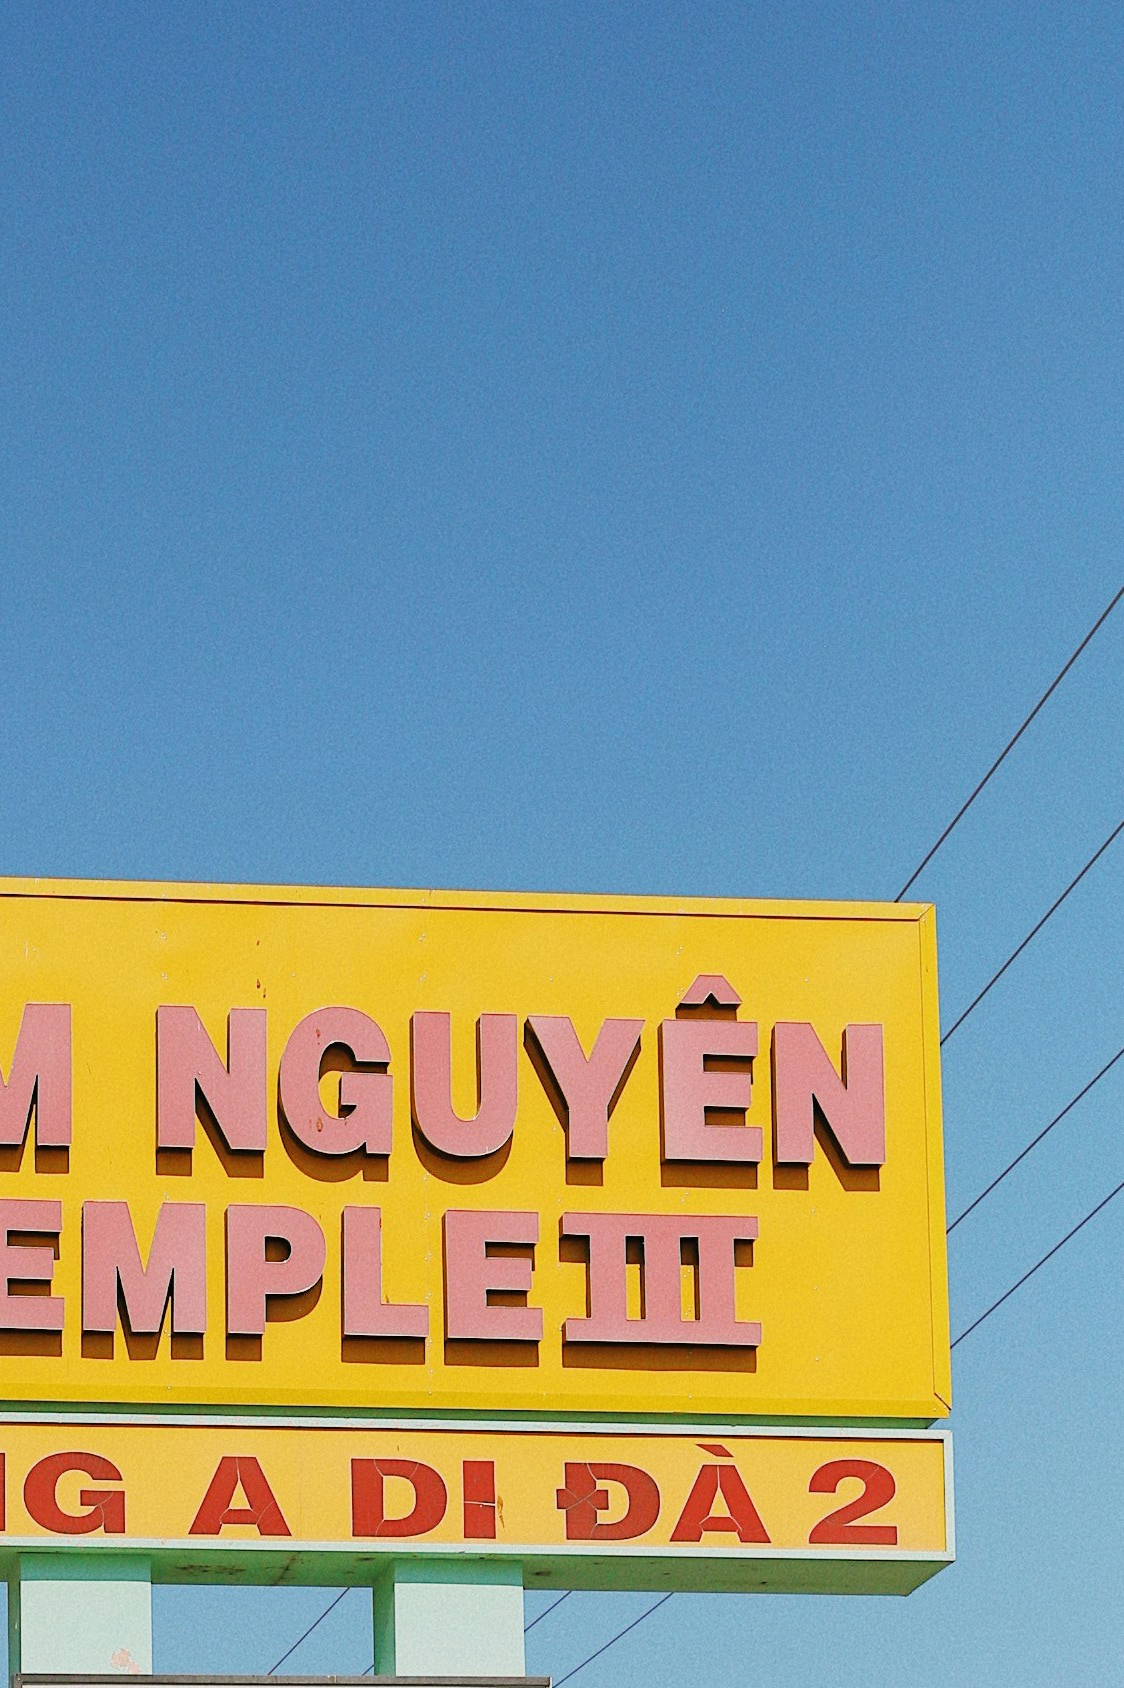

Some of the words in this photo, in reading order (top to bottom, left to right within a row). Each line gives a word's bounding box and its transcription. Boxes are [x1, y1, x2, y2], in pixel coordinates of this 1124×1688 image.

[156, 974, 886, 1167] NGUYÊN
[559, 1212, 762, 1347] III
[188, 1456, 293, 1537] A
[350, 1457, 497, 1540] DI
[556, 1443, 772, 1544] ĐÀ
[807, 1458, 898, 1546] 2
